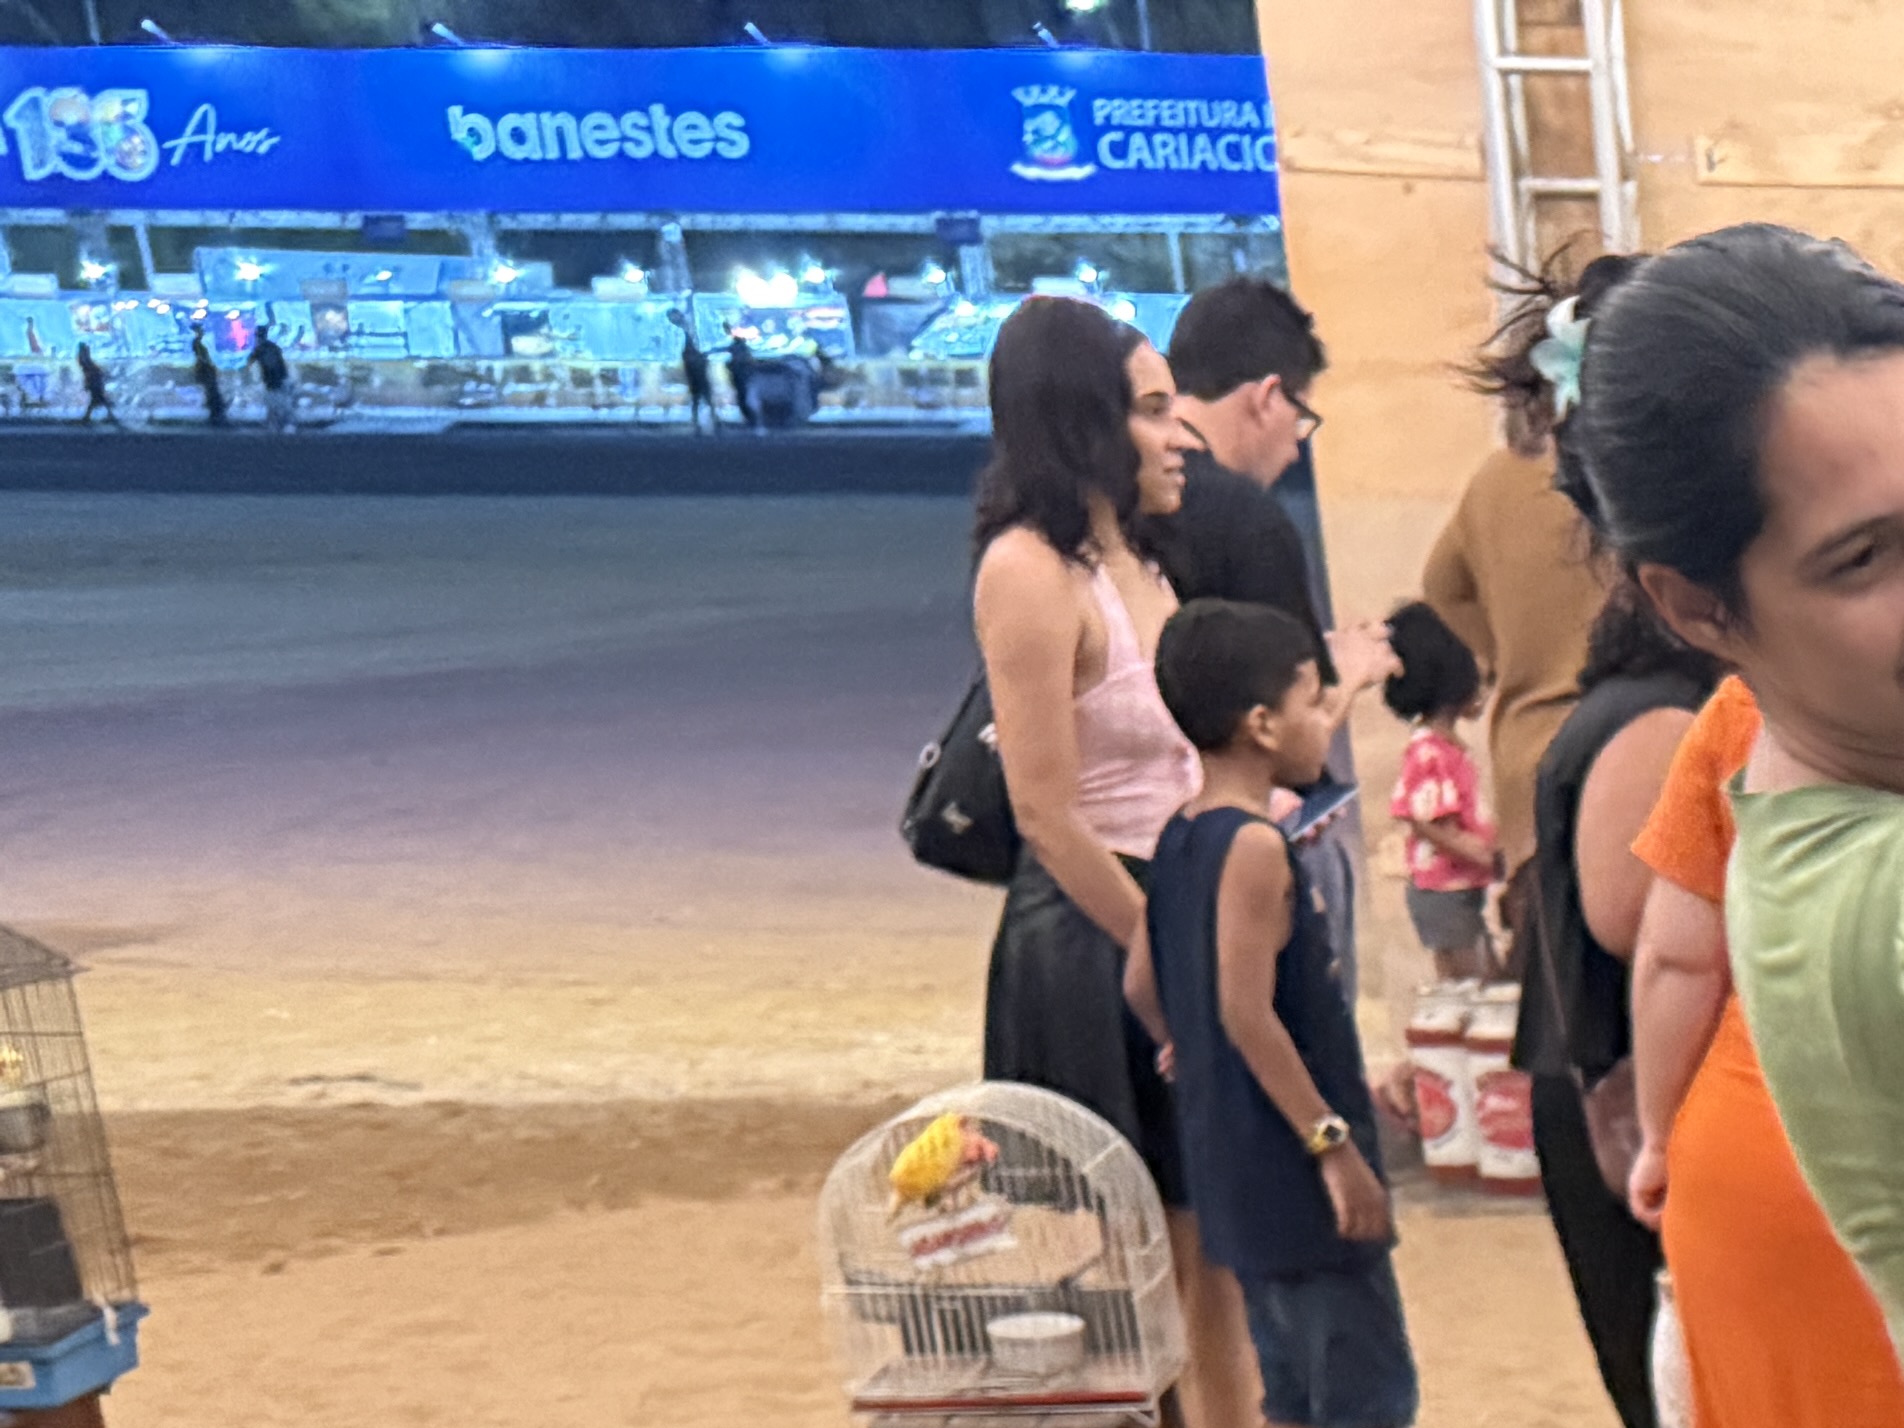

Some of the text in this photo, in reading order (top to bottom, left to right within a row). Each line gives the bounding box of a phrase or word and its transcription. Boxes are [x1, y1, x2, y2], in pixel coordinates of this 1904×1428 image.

[2, 86, 281, 182] 135 Anos
[447, 103, 751, 161] banestes
[1092, 98, 1262, 128] PREFEITURA
[1097, 131, 1277, 171] CARIACIC
